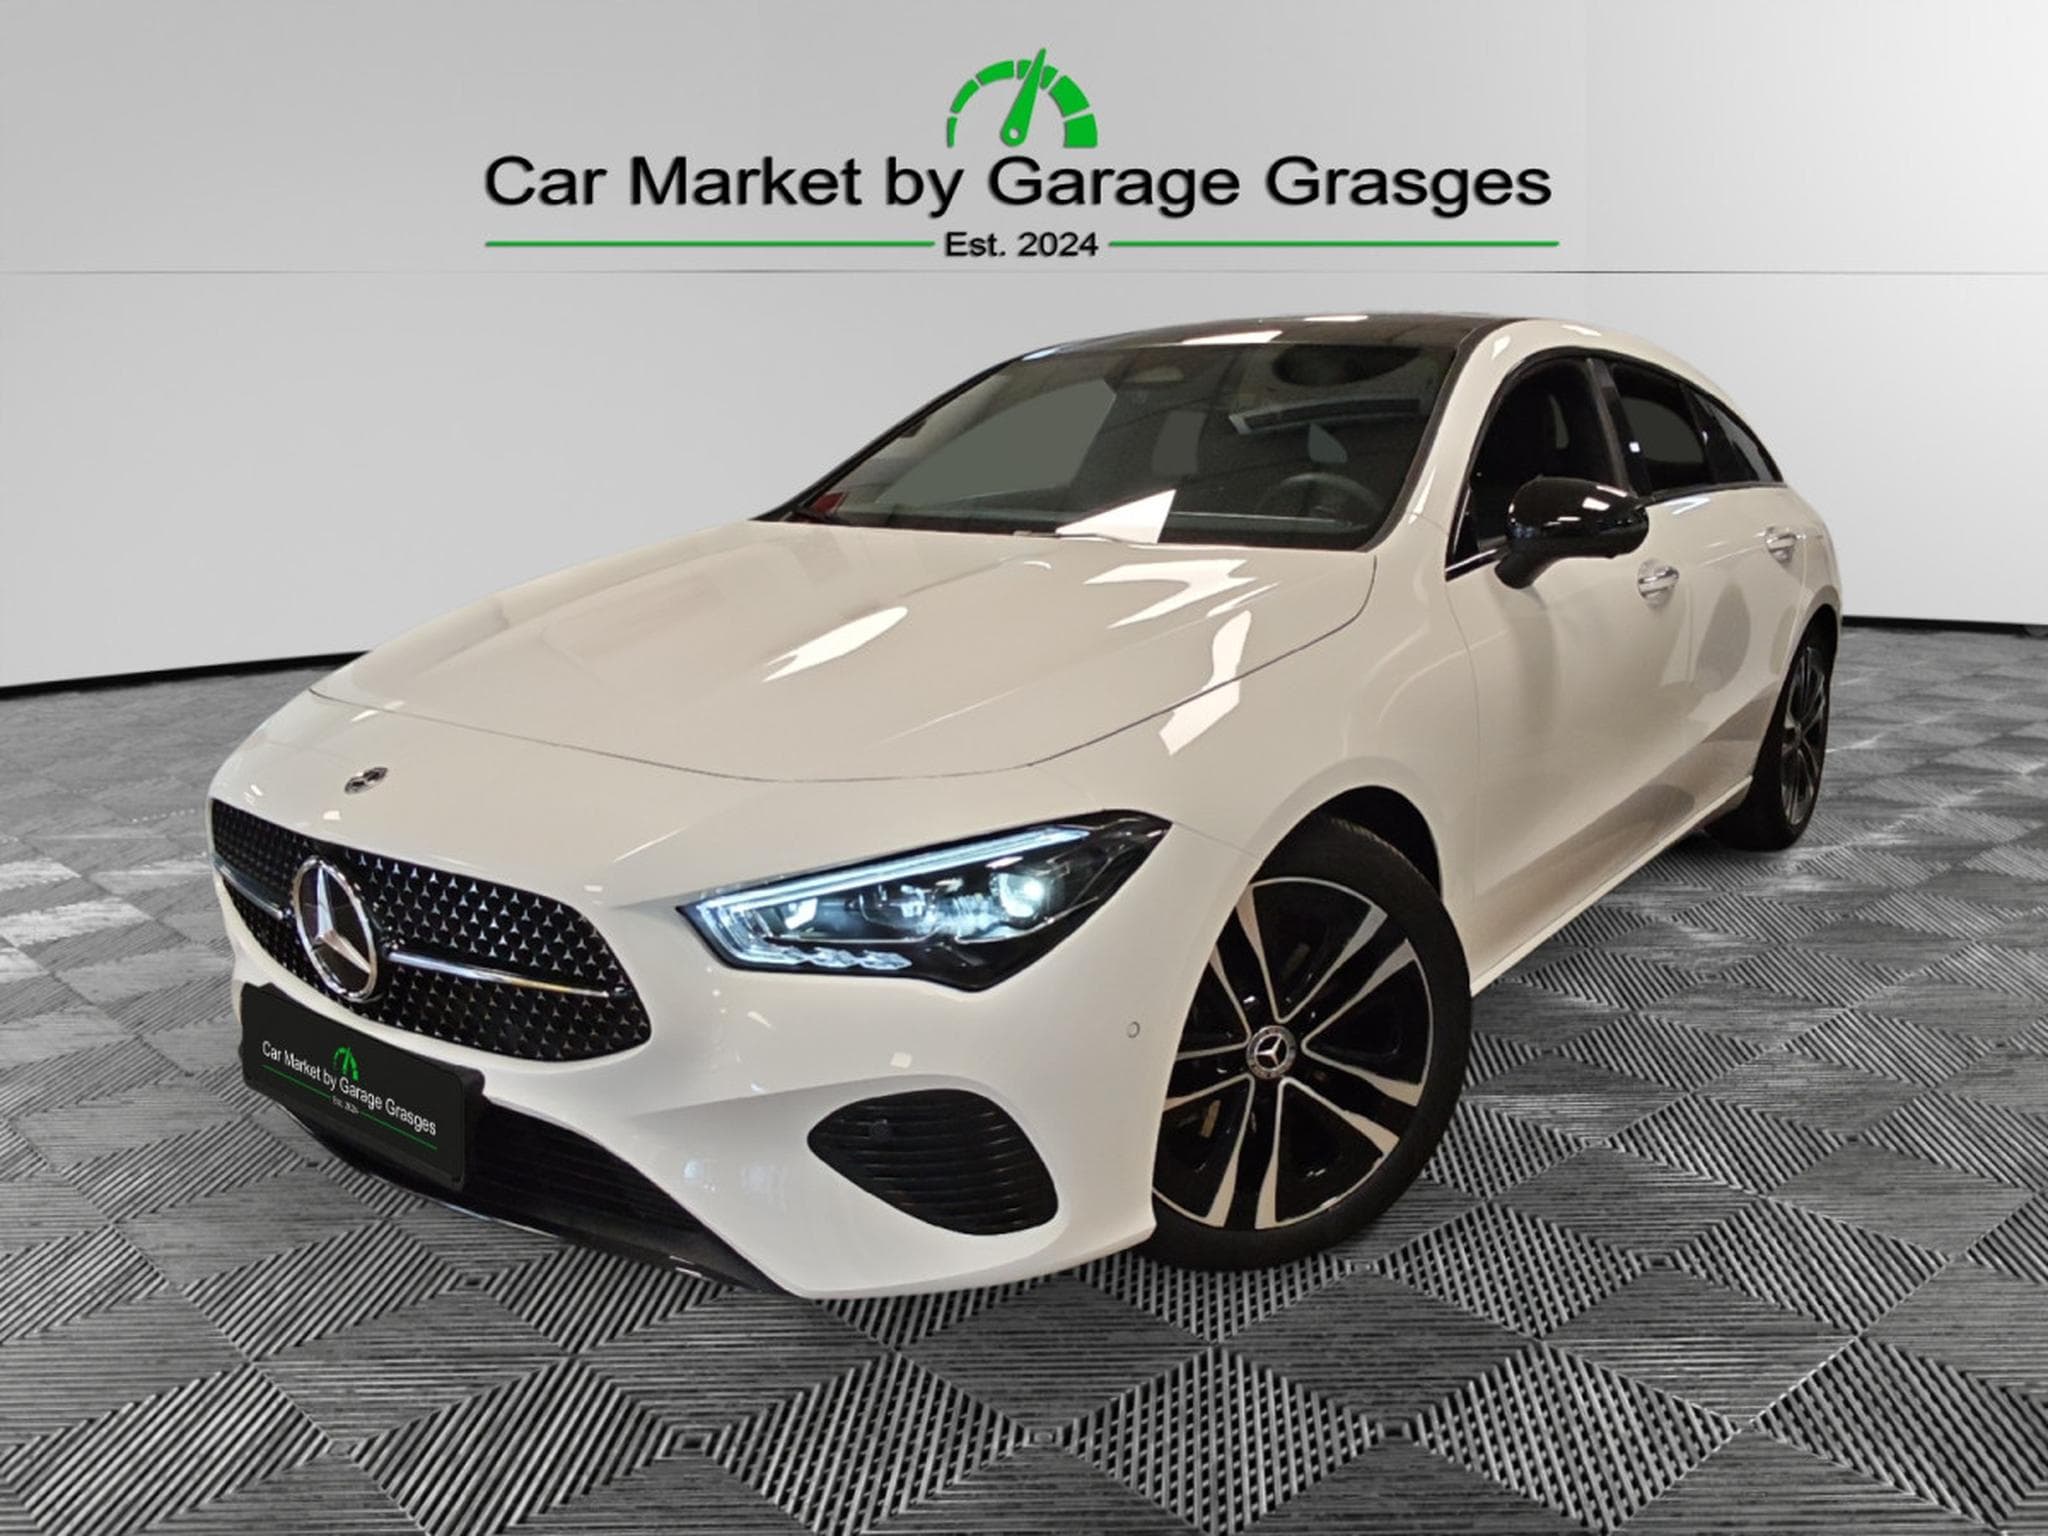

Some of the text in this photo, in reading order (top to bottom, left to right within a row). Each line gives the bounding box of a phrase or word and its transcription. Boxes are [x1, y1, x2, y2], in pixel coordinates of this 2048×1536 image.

[485, 155, 1552, 219] Car Market by Garage Grasges
[944, 231, 1099, 258] Est. 2024
[262, 1040, 282, 1062] Car
[284, 1049, 321, 1081] Market
[323, 1068, 337, 1092] by
[339, 1076, 383, 1110] Garage
[385, 1097, 437, 1136] Grasges
